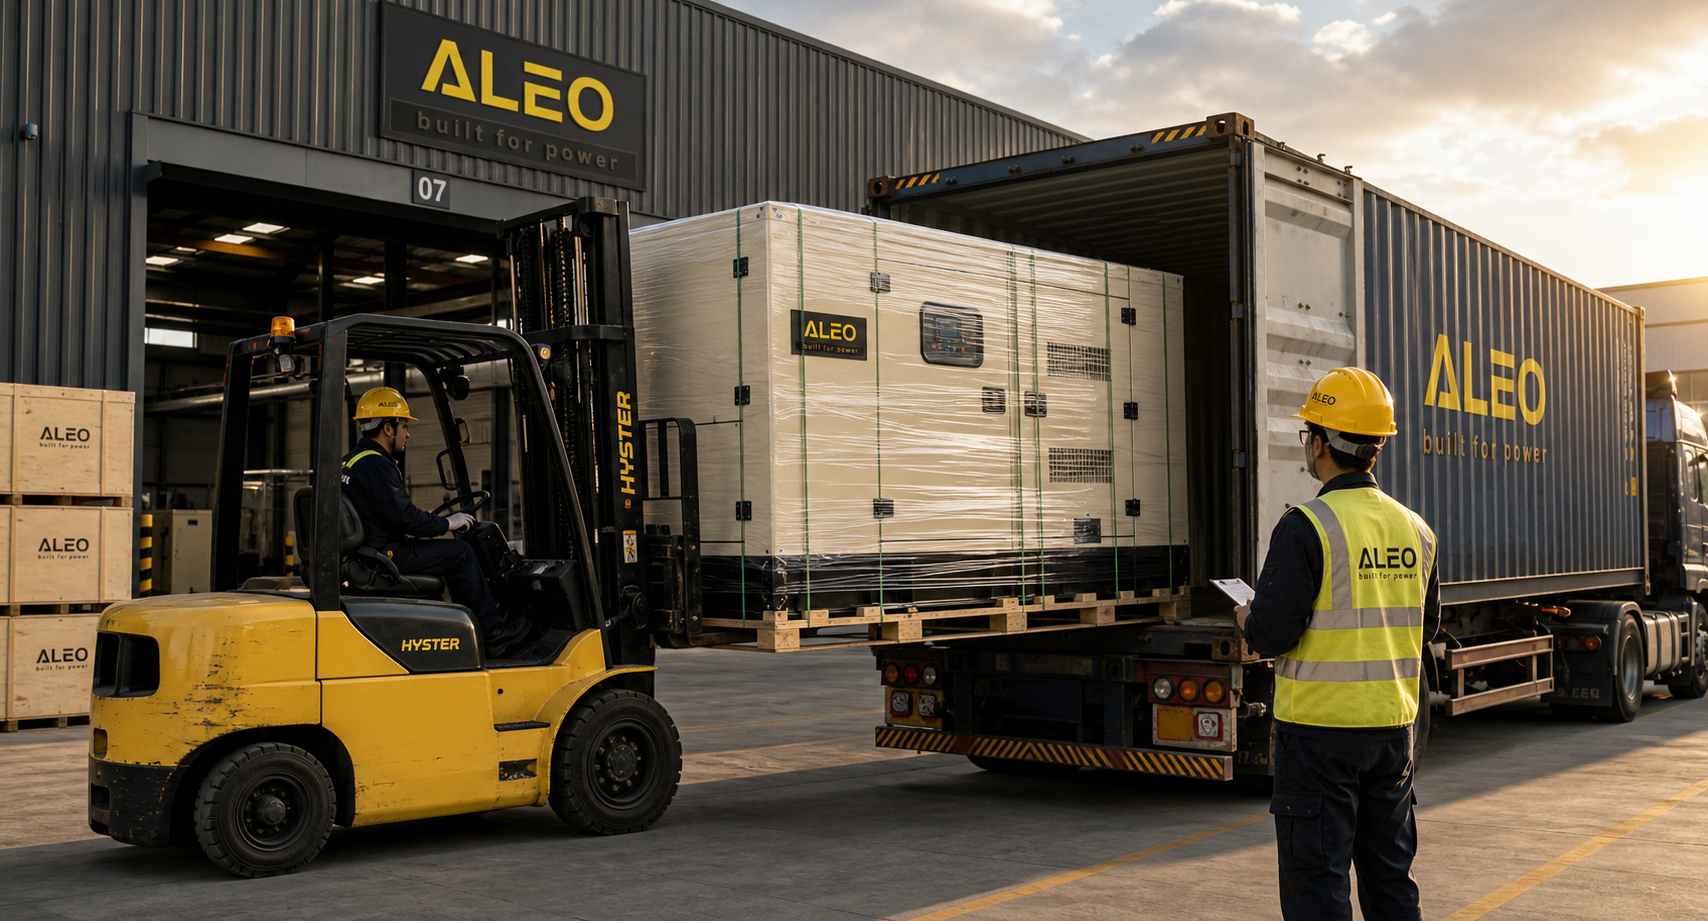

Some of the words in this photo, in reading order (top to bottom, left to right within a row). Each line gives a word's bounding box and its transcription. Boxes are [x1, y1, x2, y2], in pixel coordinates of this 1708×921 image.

[421, 38, 614, 132] ALEO
[417, 111, 484, 143] built
[496, 128, 533, 153] for
[546, 143, 618, 171] power
[418, 176, 447, 202] 07
[804, 320, 857, 341] ALEO
[1424, 333, 1546, 426] ALEO
[1311, 392, 1336, 406] ALEO
[40, 426, 90, 442] ALEO
[616, 391, 636, 495] HYSTER
[1423, 428, 1466, 458] built
[1472, 434, 1497, 460] for
[1503, 443, 1548, 467] power
[38, 538, 89, 552] ALEO
[1358, 547, 1417, 569] ALEO
[1358, 572, 1377, 580] built
[1379, 572, 1391, 580] for
[1393, 573, 1417, 581] power
[36, 647, 88, 664] ALEO
[401, 638, 460, 652] HYSTER
